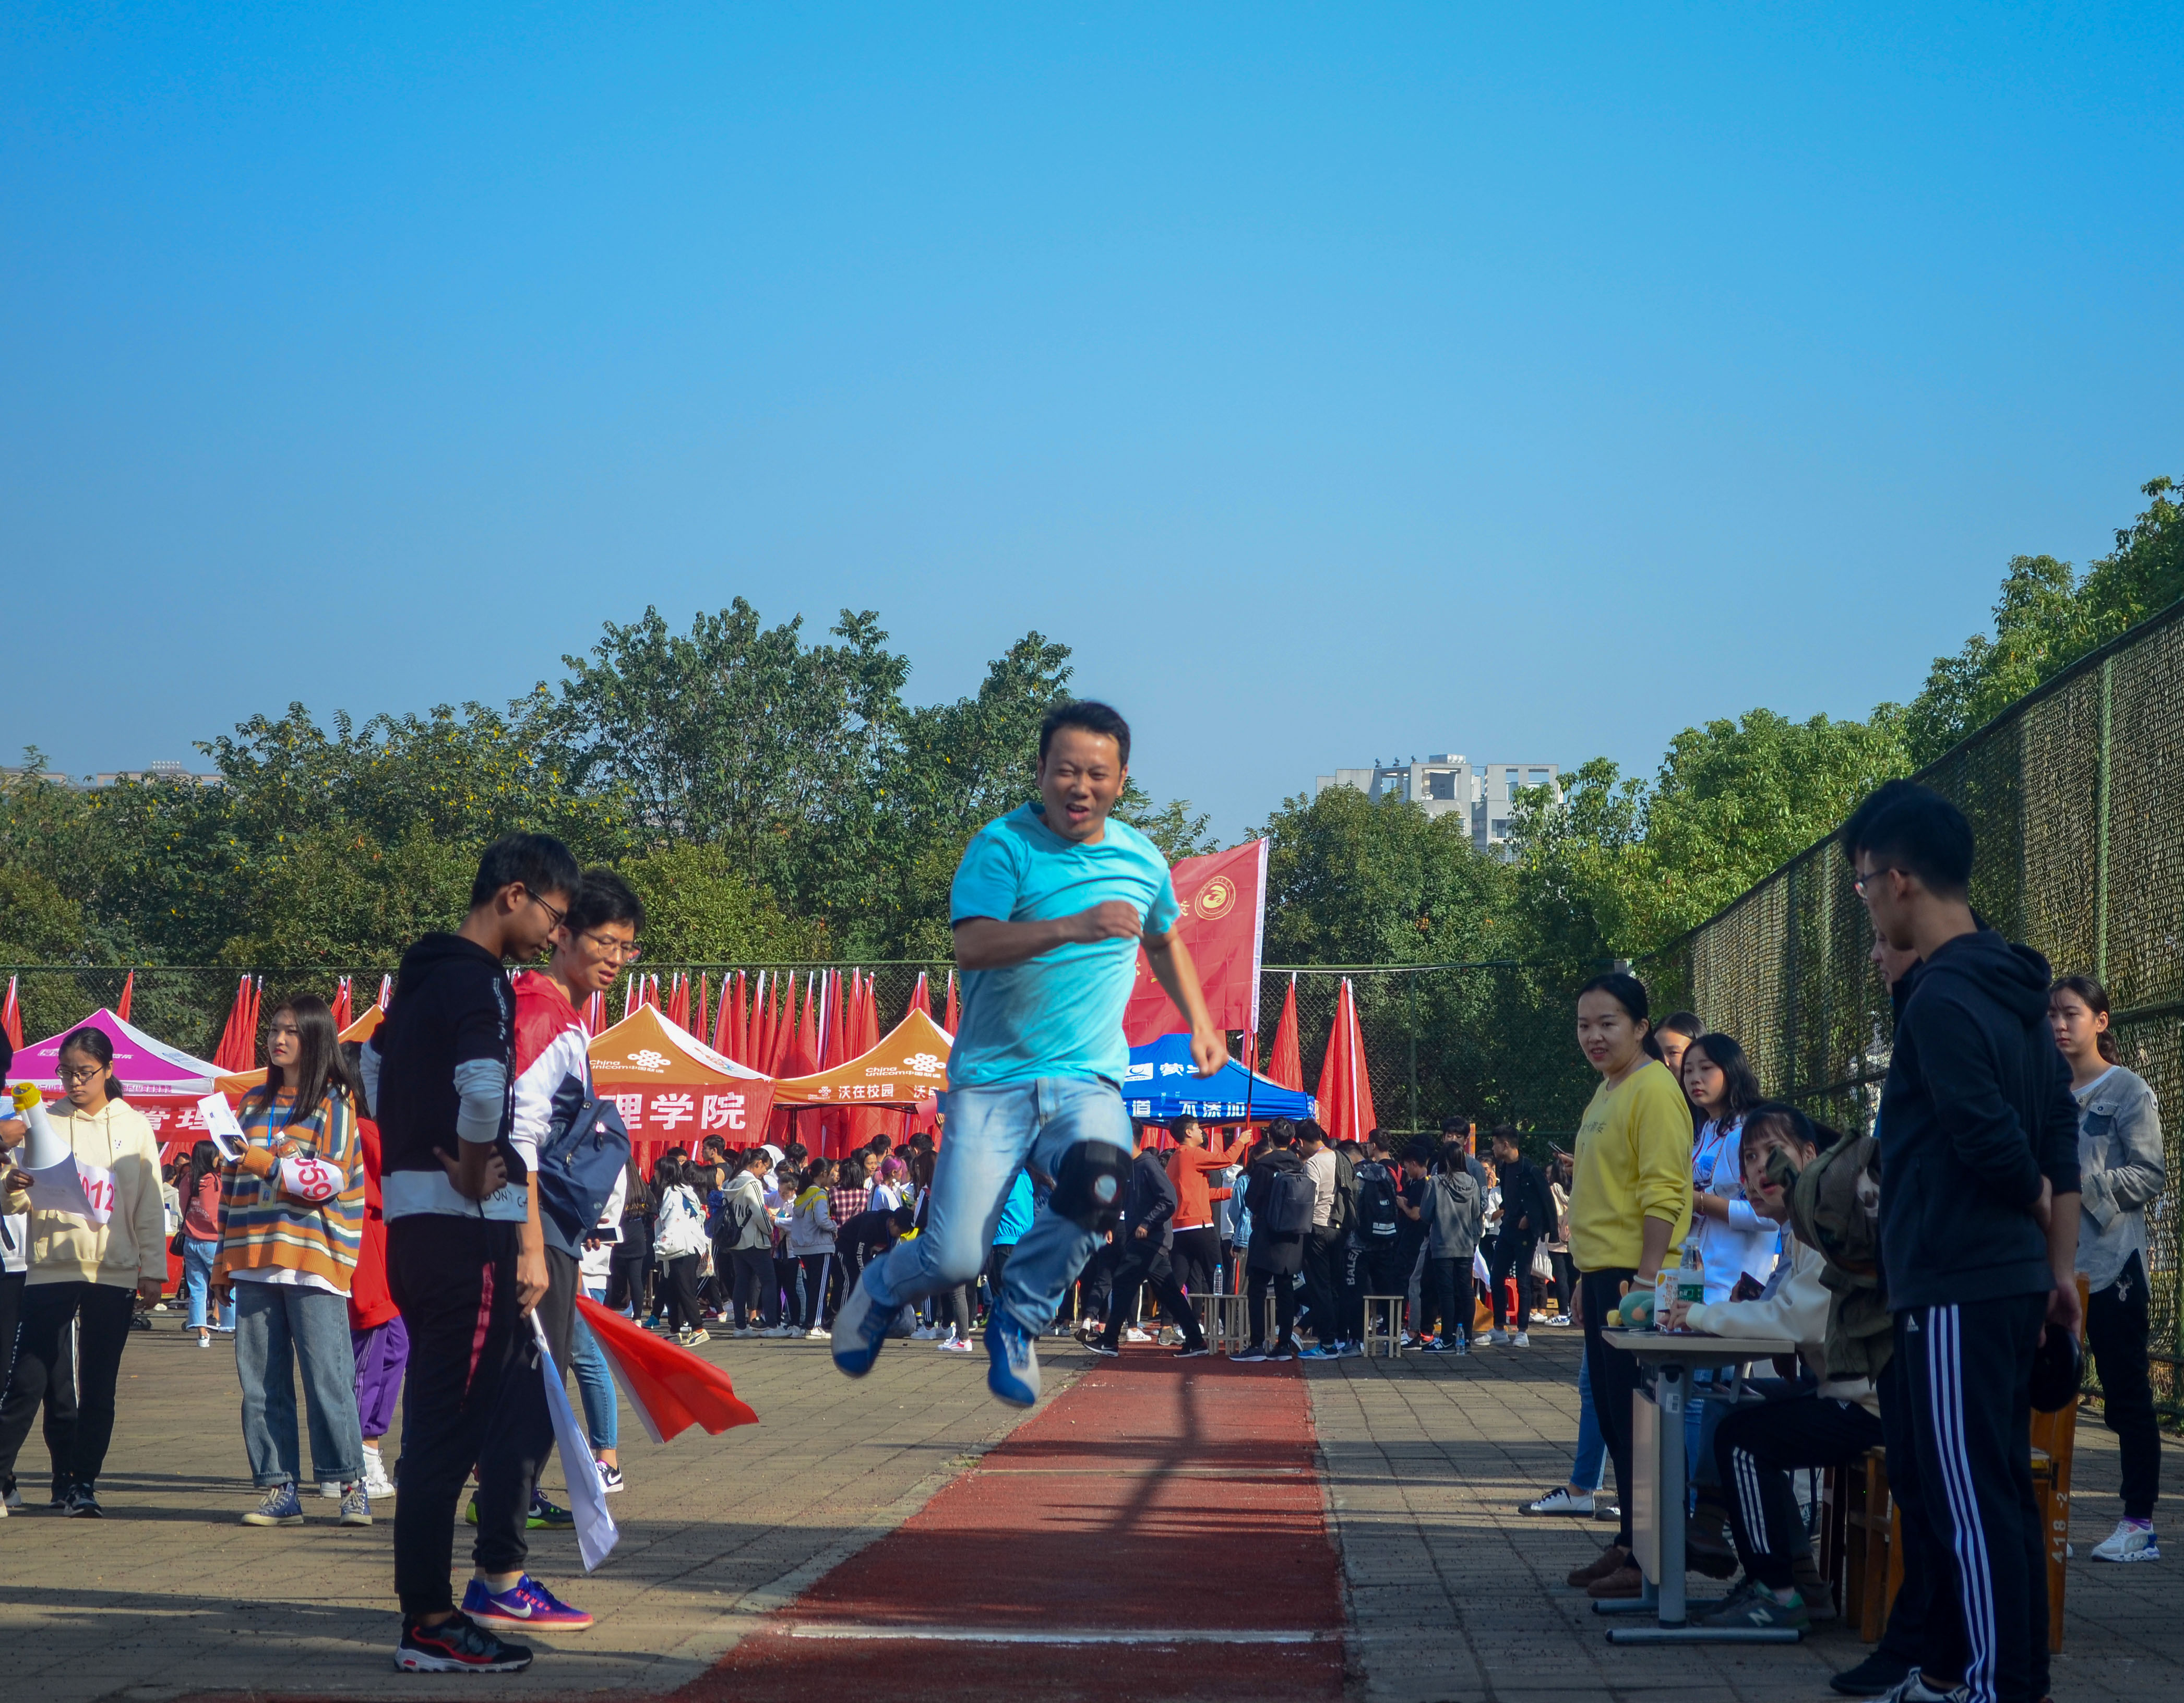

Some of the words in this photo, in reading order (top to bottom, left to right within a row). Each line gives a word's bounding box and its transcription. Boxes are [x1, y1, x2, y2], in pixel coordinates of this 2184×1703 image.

[838, 1084, 894, 1099] 沃在校园
[132, 1105, 236, 1130] 管理
[78, 1172, 114, 1212] 012
